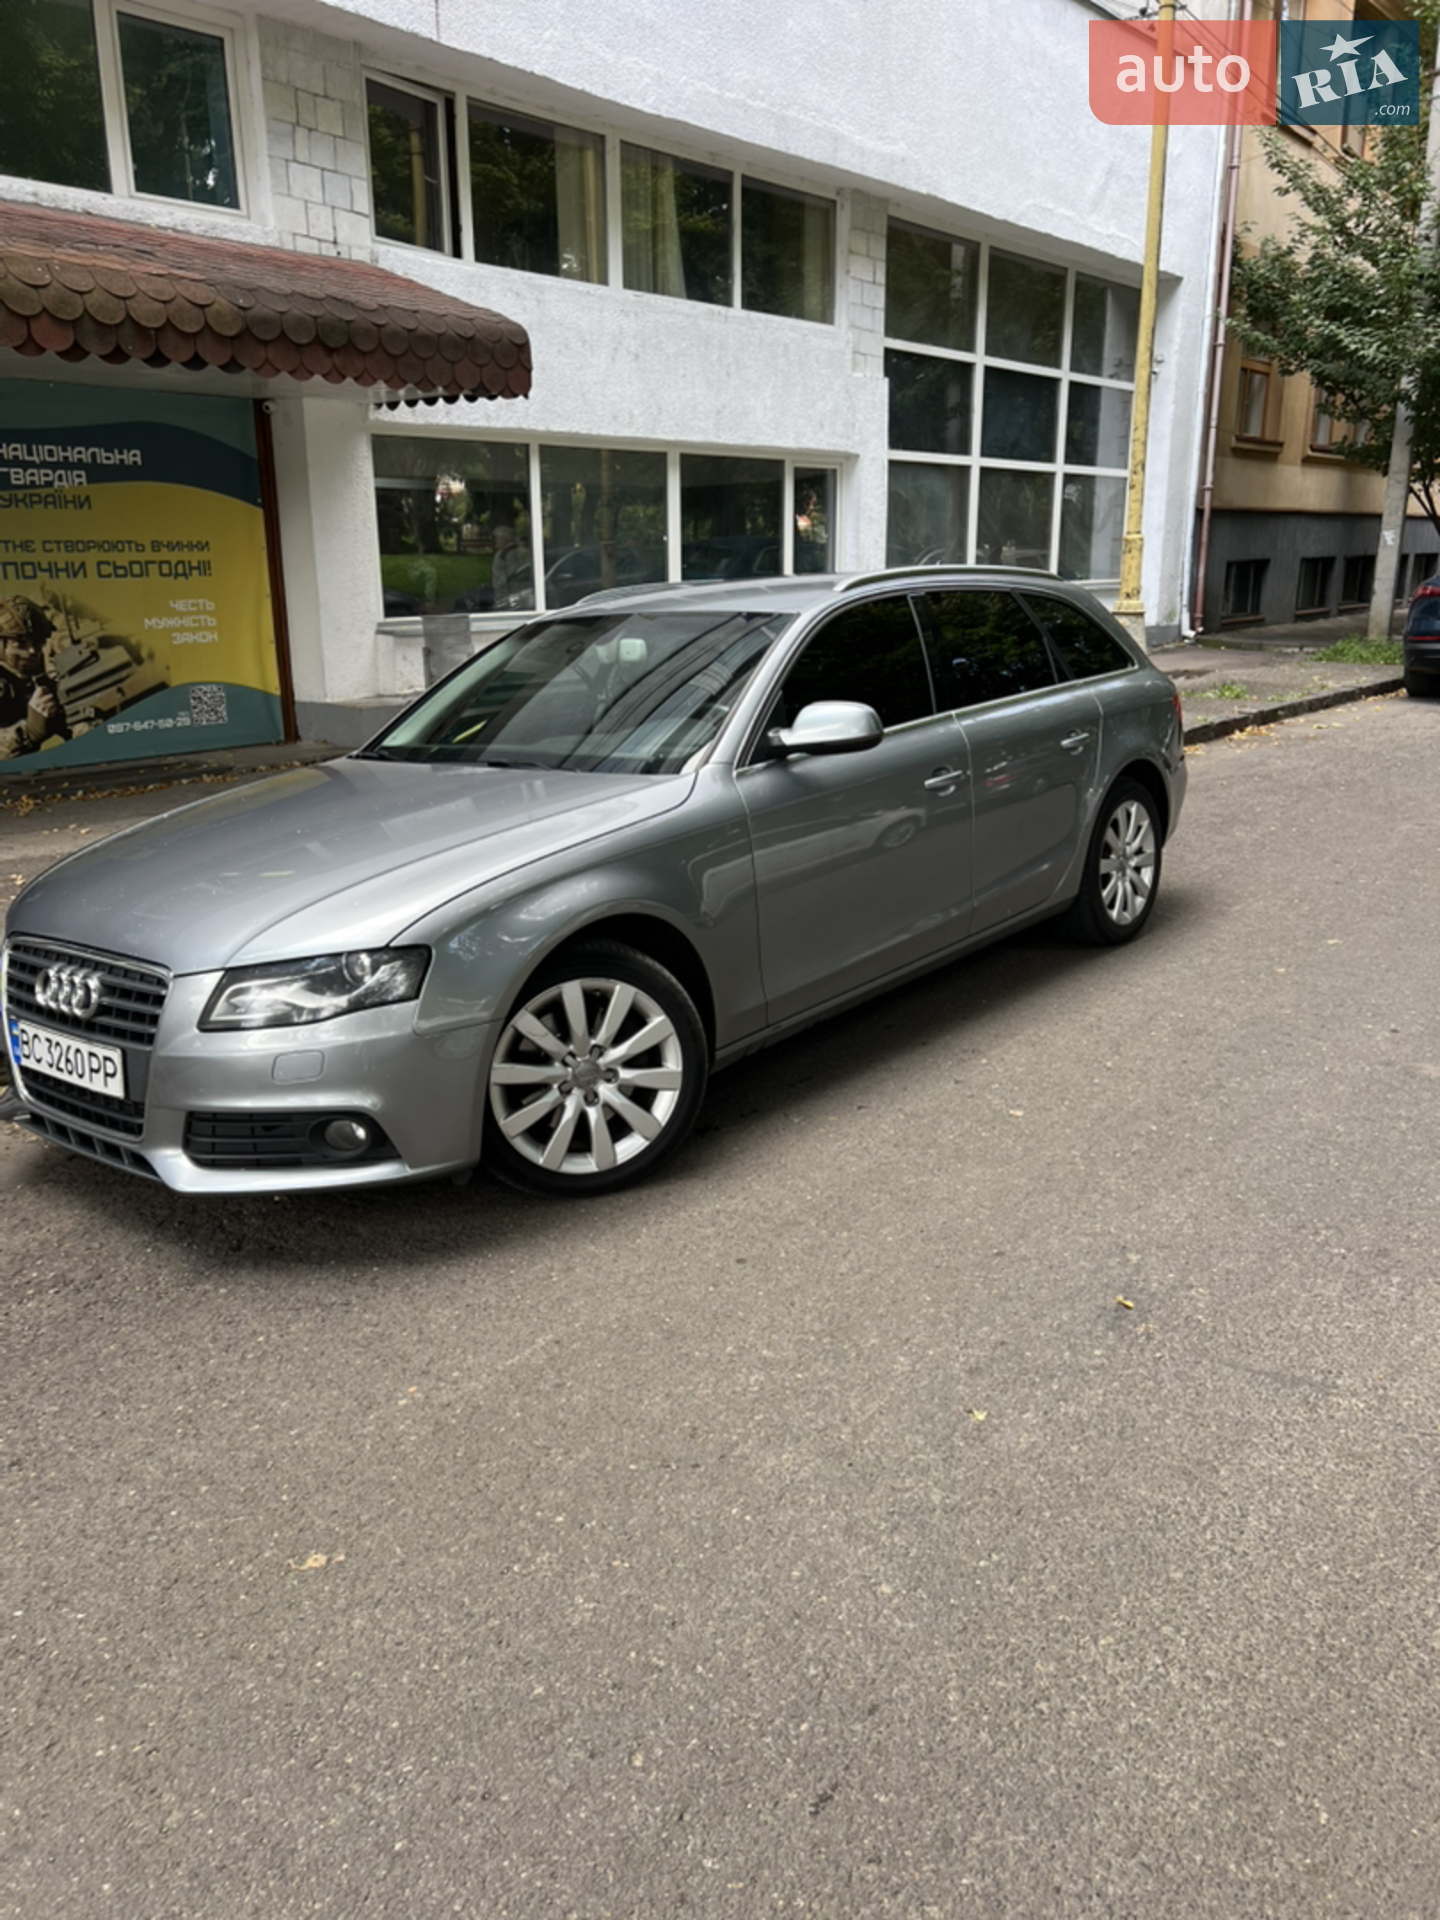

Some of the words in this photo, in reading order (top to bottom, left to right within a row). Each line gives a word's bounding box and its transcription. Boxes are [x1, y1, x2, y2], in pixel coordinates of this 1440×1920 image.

[0, 442, 142, 466] НАЦІОНАЛЬНА
[0, 489, 92, 510] УКРАЇНИ
[42, 539, 146, 553] СТВОРЮЮТЬ
[151, 540, 211, 552] ВЧИНКИ
[2, 560, 88, 580] ПОЧНИ
[96, 560, 212, 580] СЬОГОДНІ!
[169, 599, 215, 612] ЧЕСТЬ
[143, 615, 217, 630] МУЖНІСТЬ
[171, 631, 218, 645] ЗАКОН
